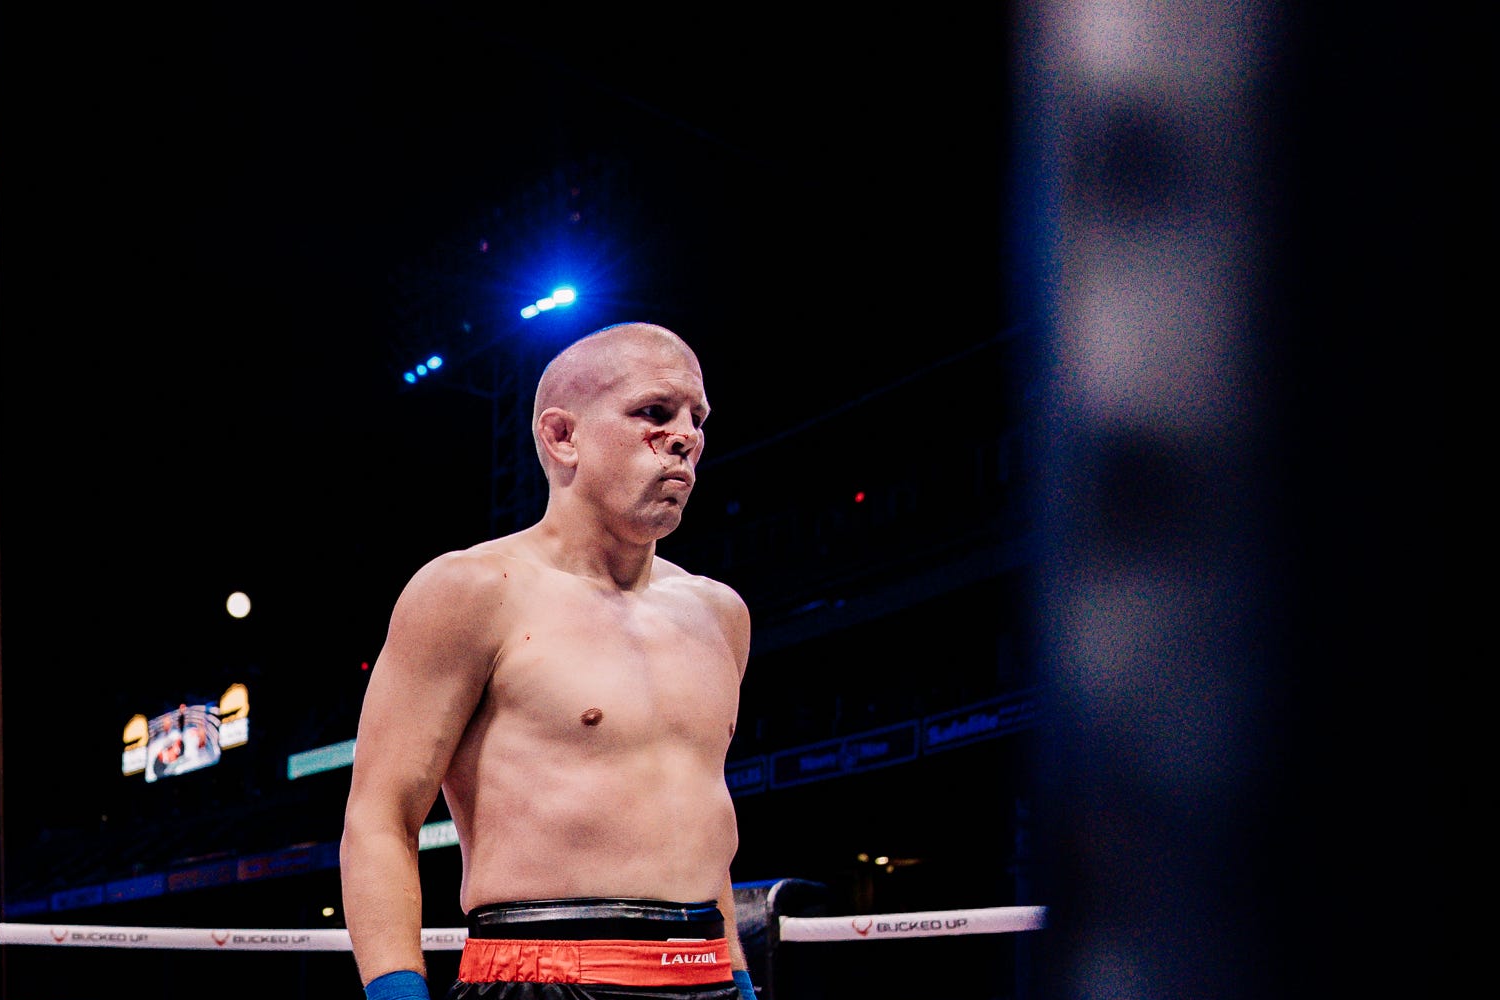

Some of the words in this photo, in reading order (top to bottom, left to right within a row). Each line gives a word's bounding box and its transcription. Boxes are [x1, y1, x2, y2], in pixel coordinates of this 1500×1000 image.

[877, 920, 942, 932] BUCKED
[946, 918, 968, 930] UP
[72, 932, 127, 943] BUCKED
[233, 934, 289, 944] BUCKED
[661, 952, 718, 966] LAUZON
